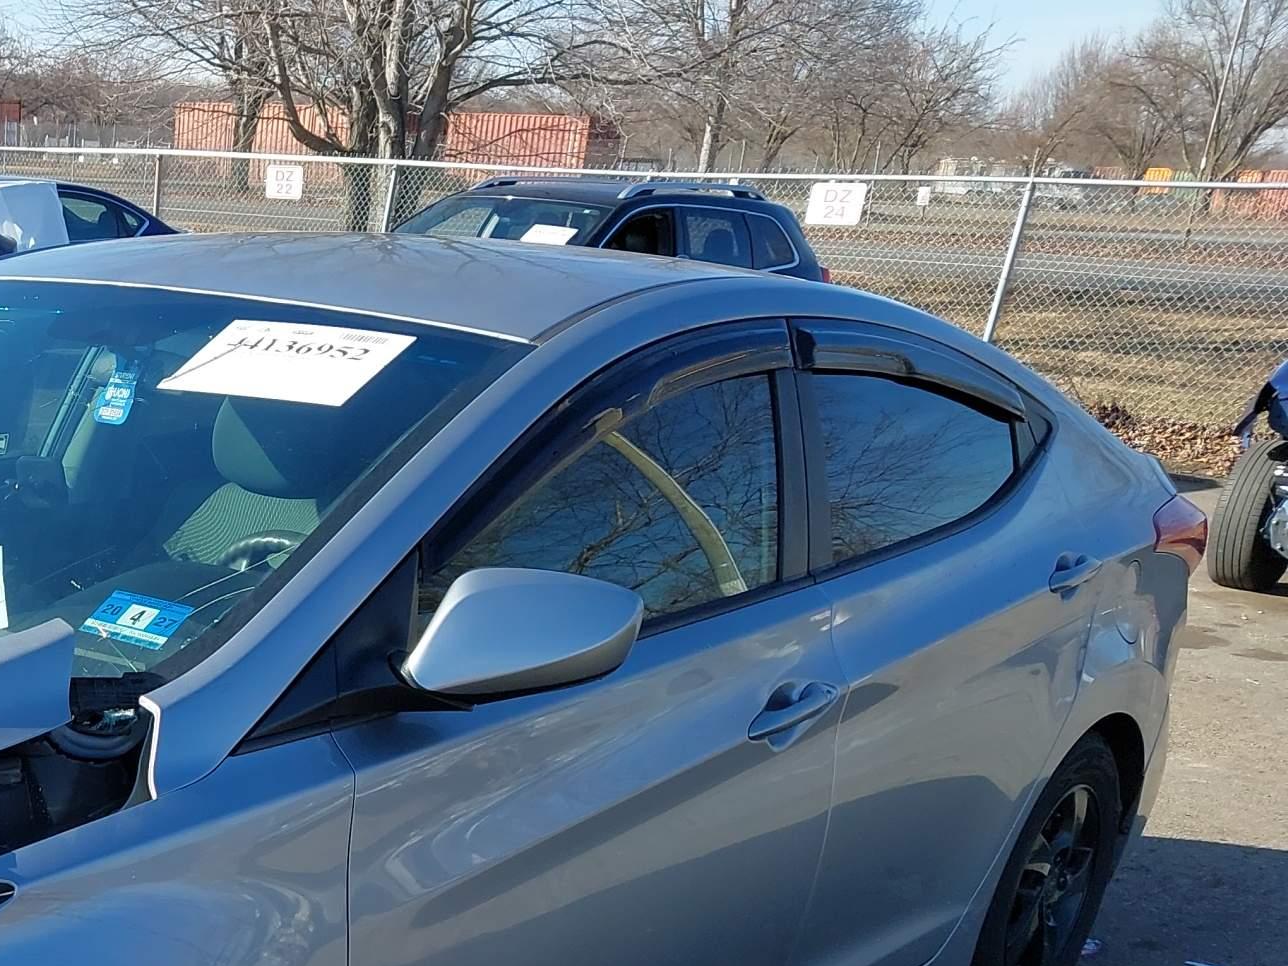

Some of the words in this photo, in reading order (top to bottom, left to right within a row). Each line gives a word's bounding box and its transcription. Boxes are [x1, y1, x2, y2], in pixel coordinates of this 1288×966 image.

[275, 170, 294, 182] DZ
[276, 183, 292, 194] 22
[824, 190, 852, 203] DZ
[824, 206, 845, 219] 24
[102, 604, 122, 616] 20
[130, 610, 146, 626] 4
[154, 617, 177, 629] 27
